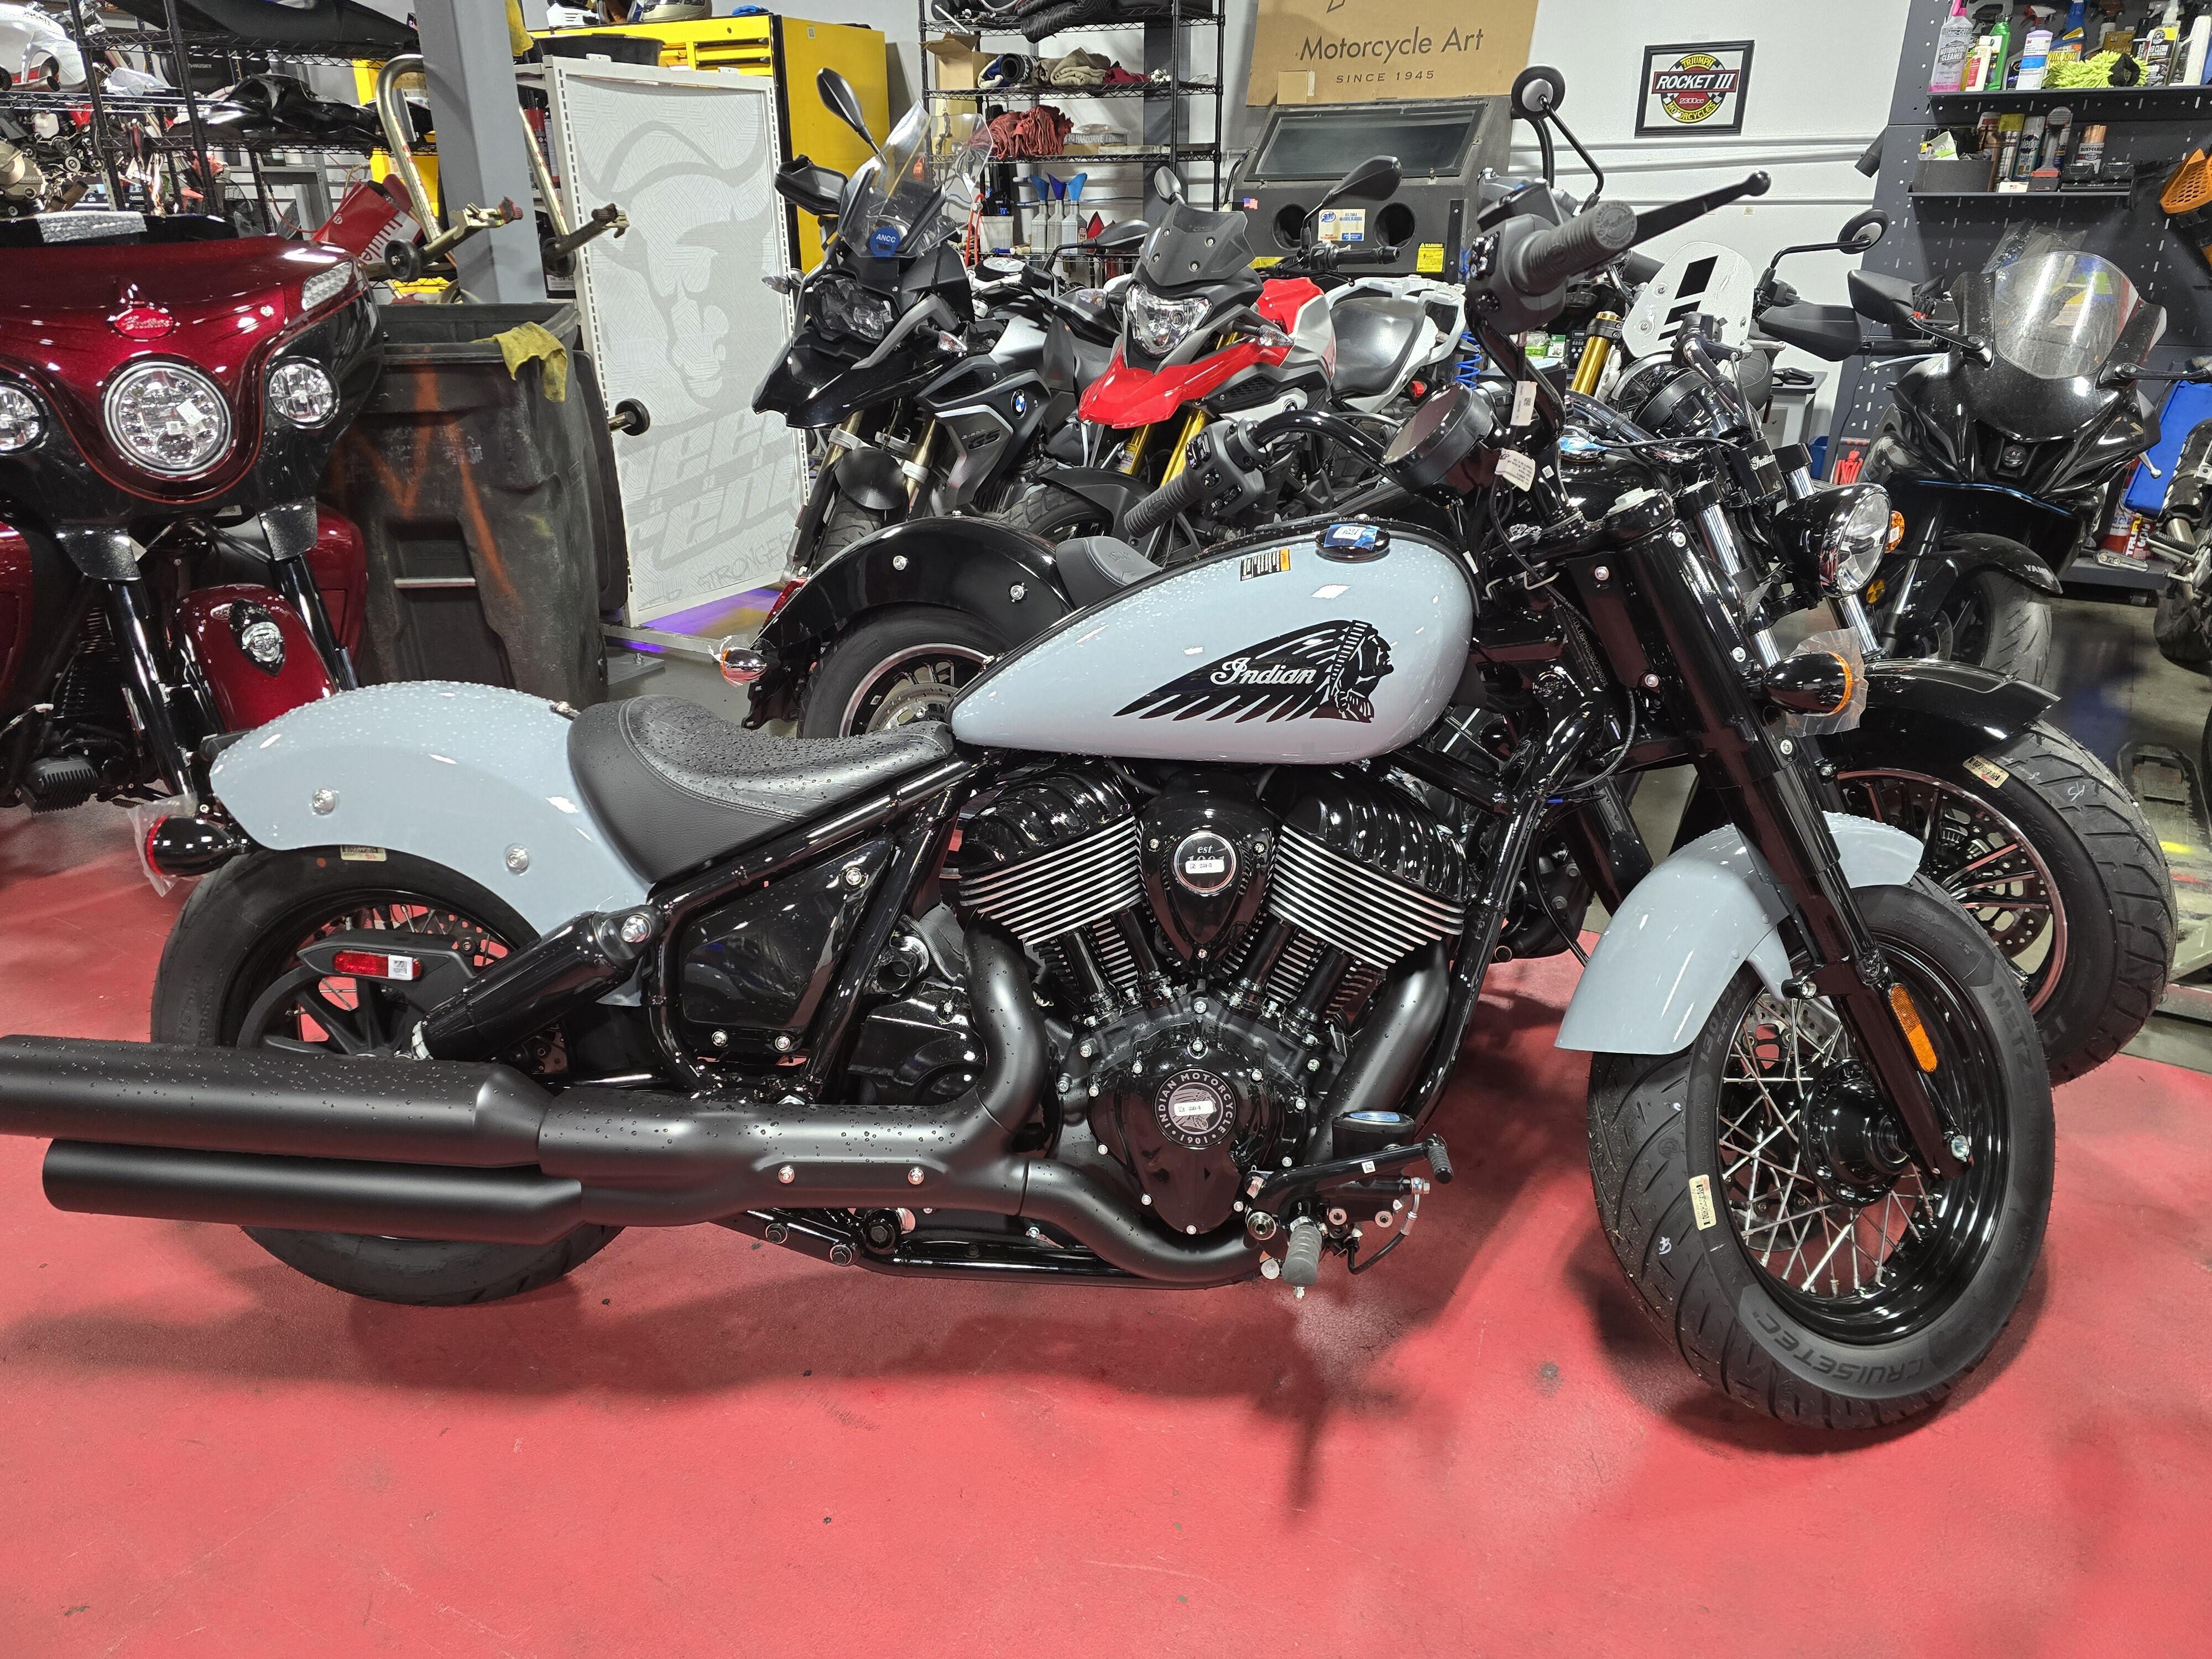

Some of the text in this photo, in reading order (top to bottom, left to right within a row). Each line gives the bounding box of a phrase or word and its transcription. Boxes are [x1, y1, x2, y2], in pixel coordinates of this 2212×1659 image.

[1300, 26, 1484, 64] Motorcycle Art
[1682, 56, 1714, 68] TRIUMPH
[1336, 70, 1434, 83] SINCE 1945
[1656, 74, 1736, 90] ROCKET III
[876, 233, 896, 243] ANCC
[1210, 657, 1317, 685] Indian
[1158, 1072, 1234, 1134] INDIAN MOTORCYCLE
[1180, 1134, 1208, 1144] 1901
